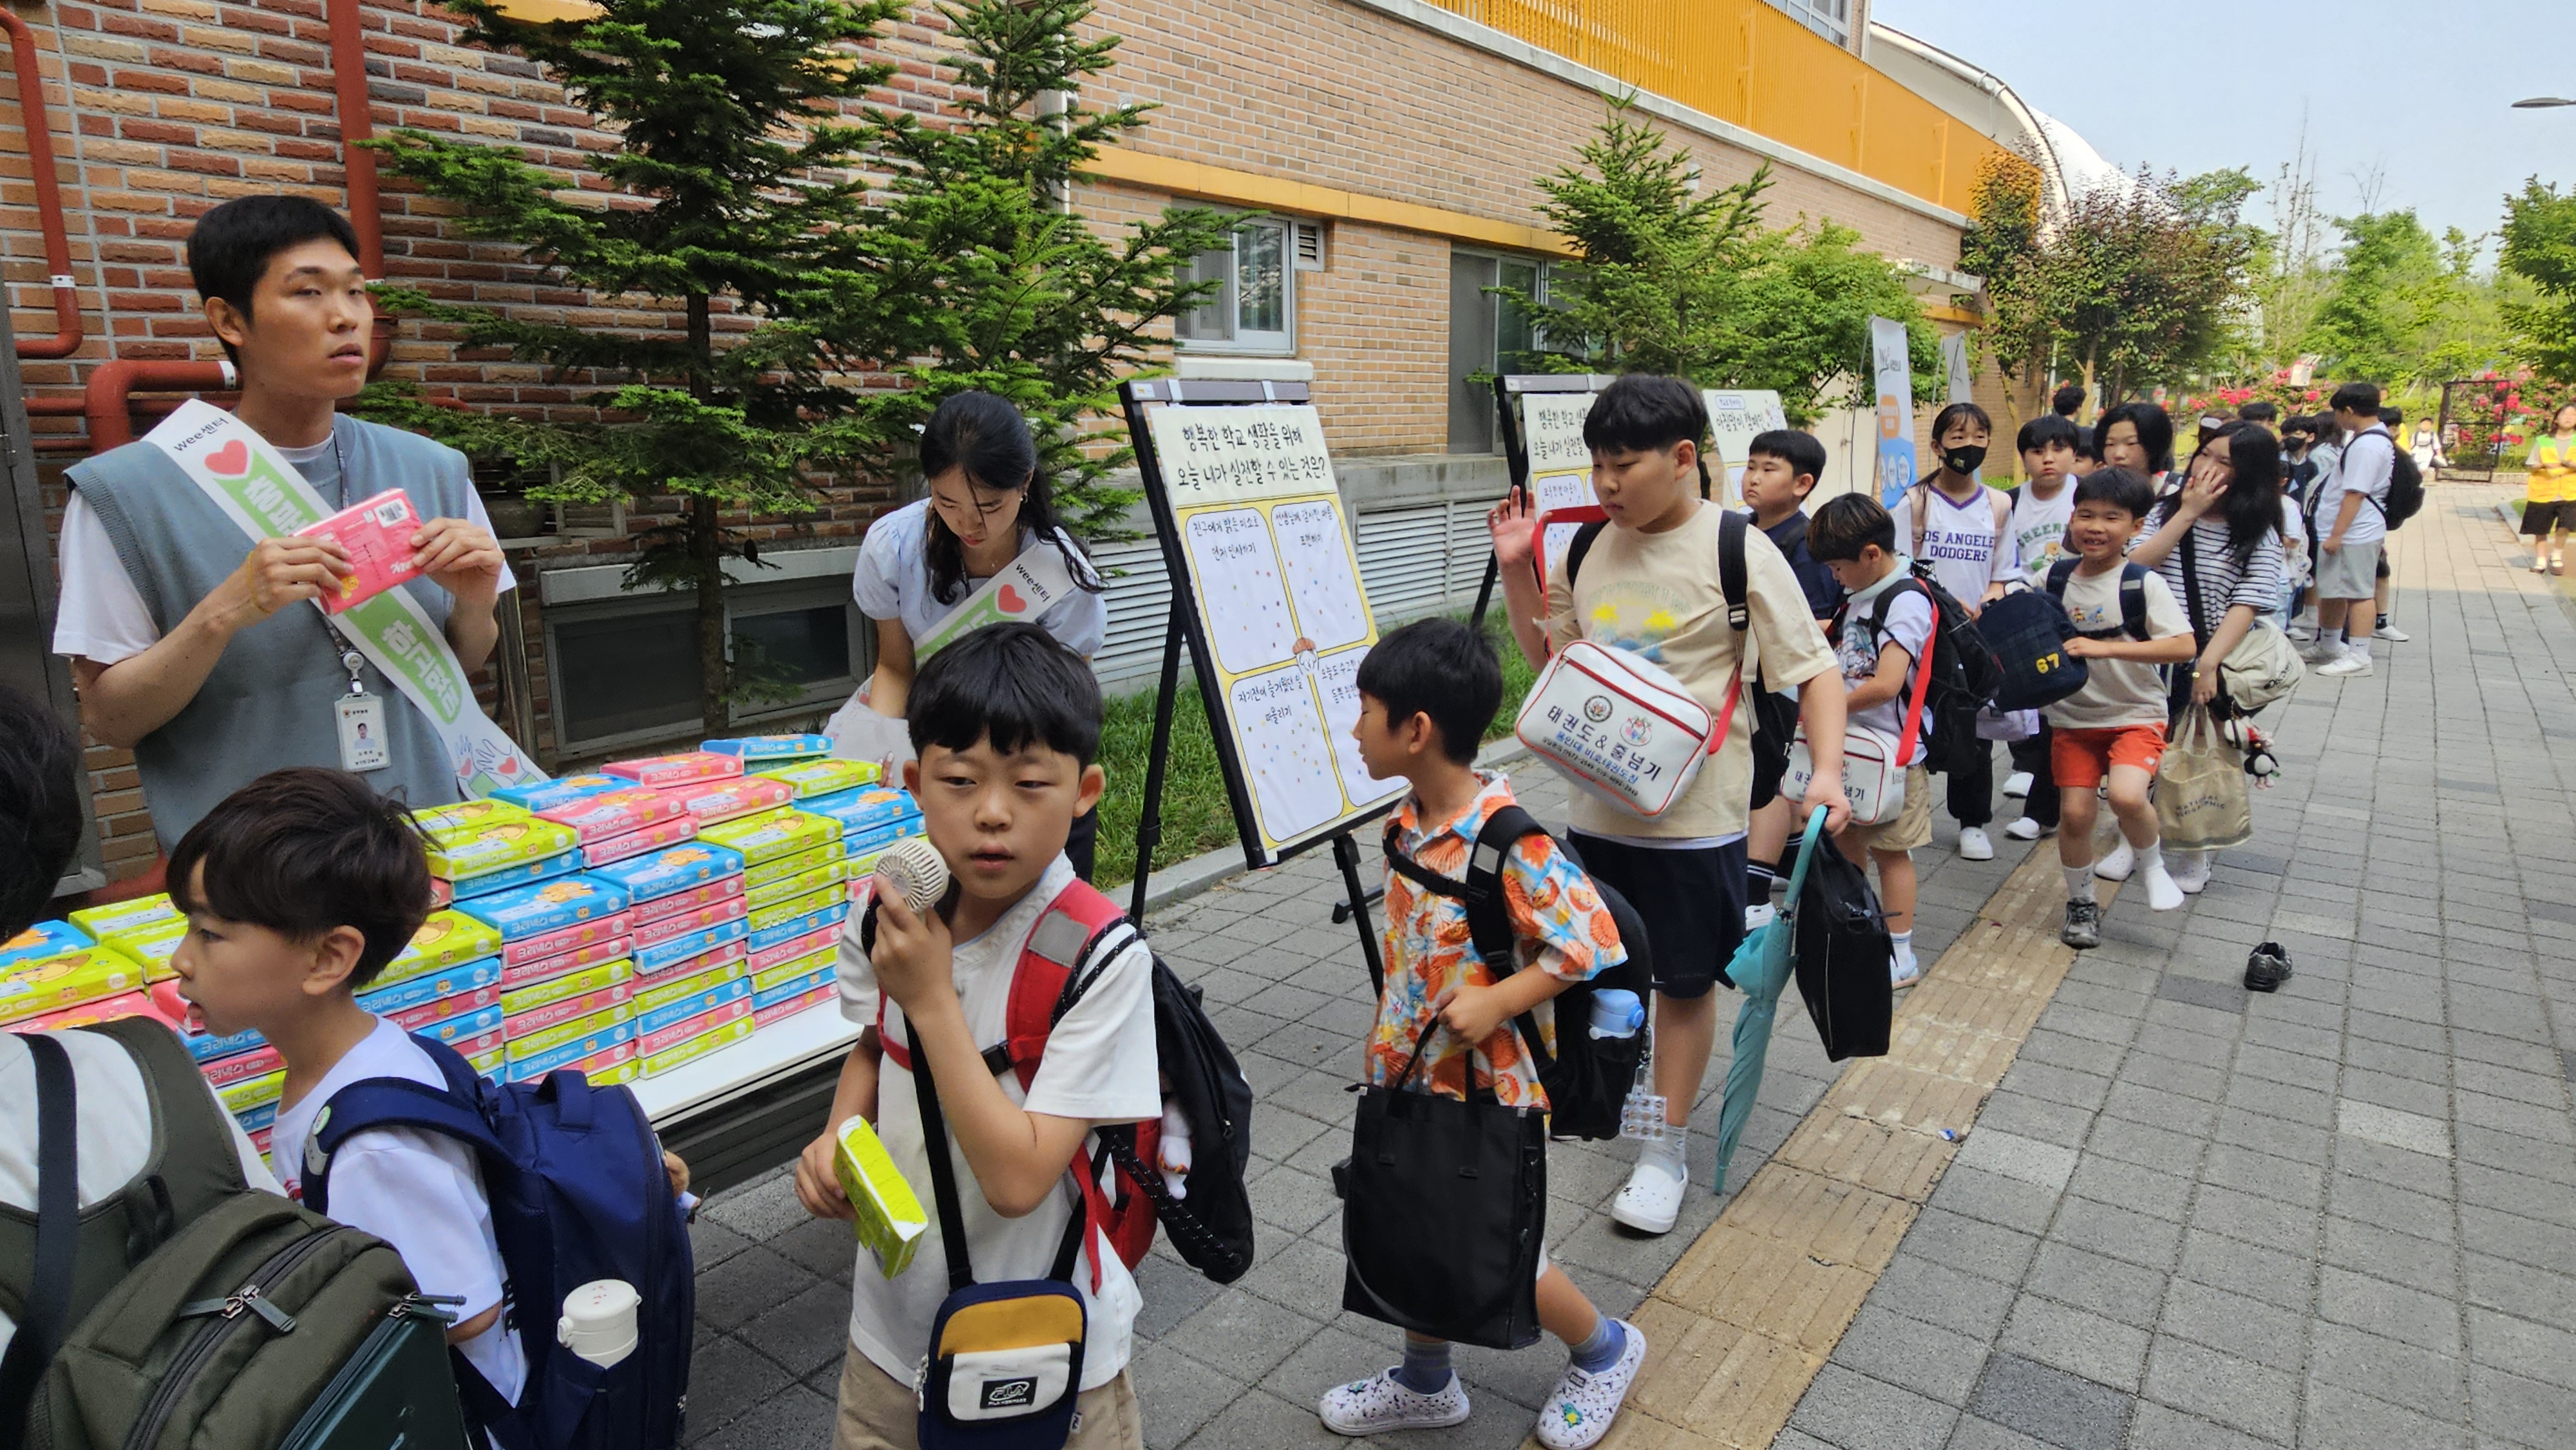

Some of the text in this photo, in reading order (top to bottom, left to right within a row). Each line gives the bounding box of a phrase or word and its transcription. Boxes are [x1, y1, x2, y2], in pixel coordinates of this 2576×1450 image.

[1539, 408, 1560, 429] 행복한
[1562, 409, 1575, 429] 학교
[1716, 411, 1766, 431] 아침맞이 캠페인
[1183, 422, 1303, 451] 행복한 학교 생활을 위해
[1535, 437, 1547, 459] 오늘
[1549, 439, 1562, 455] 내가
[1179, 456, 1326, 490] 오늘 내가 실천할 수 있는 것은?
[243, 475, 308, 538] 충분
[1193, 515, 1259, 536] 친구에게 밝은 미소로
[1924, 531, 1994, 548] OS ANGELE
[1229, 542, 1256, 559] 인사하기
[1931, 545, 1987, 562] DODGERS
[1322, 665, 1338, 680] 오늘도
[2036, 653, 2060, 674] 67
[1268, 677, 1294, 699] 즐거웠던
[1295, 673, 1303, 690] 일
[1265, 706, 1292, 724] 떠올리기
[1548, 705, 1662, 782] 태권도 & 줄넘기
[517, 942, 554, 958] 크리넥스
[517, 1012, 554, 1030] 크리넥스
[993, 1383, 1027, 1398] FILA
